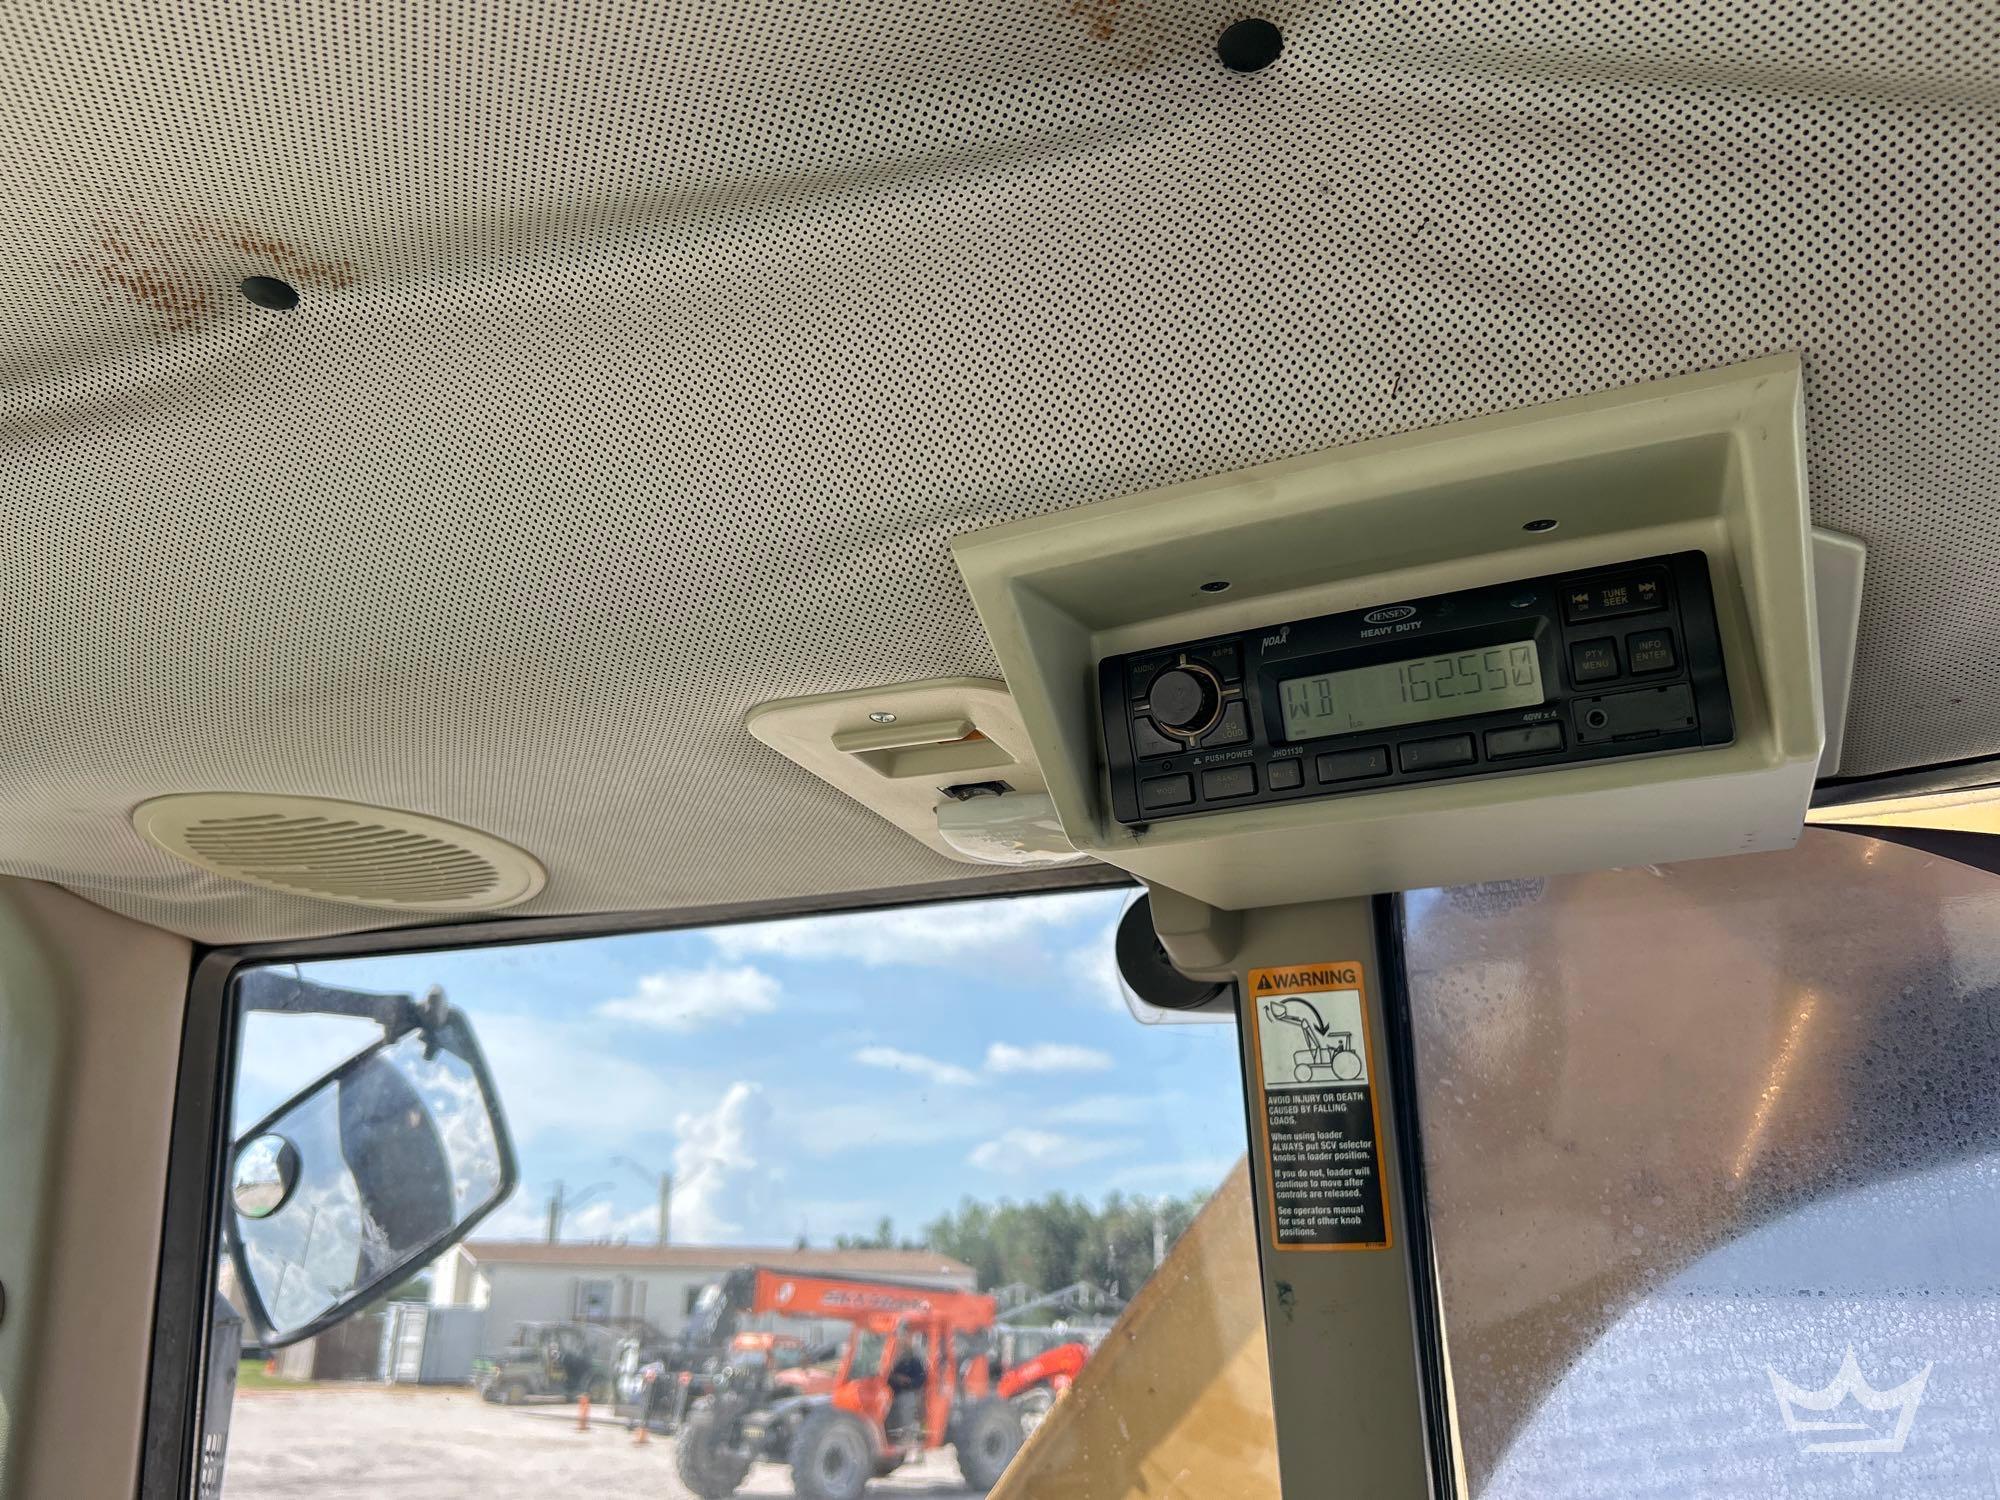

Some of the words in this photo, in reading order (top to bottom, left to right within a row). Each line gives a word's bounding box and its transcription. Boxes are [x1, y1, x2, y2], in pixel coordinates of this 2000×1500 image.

[1601, 587, 1627, 598] TUNE
[1603, 597, 1629, 607] SEEK
[1370, 607, 1410, 622] JENSEN
[1360, 627, 1393, 638] HEAVY
[1396, 621, 1423, 633] DUTY
[1261, 635, 1287, 656] NOAA
[1639, 640, 1662, 650] INFO
[1635, 650, 1667, 662] ENTER
[1583, 659, 1609, 671] MENU
[1287, 678, 1334, 720] WB
[1523, 712, 1542, 721] 40W
[1205, 753, 1225, 763] PUSH
[1226, 750, 1253, 760] POWER
[1368, 756, 1376, 767] 2
[1273, 969, 1356, 988] WARNING
[1269, 1095, 1290, 1104] AVOID
[1293, 1094, 1320, 1103] INJURY
[1323, 1094, 1334, 1102] OR
[1337, 1092, 1363, 1101] DEATH
[1269, 1106, 1298, 1115] CAUSED
[1300, 1105, 1311, 1113] BY
[1313, 1103, 1347, 1112] FALLING
[1270, 1116, 1297, 1125] LOADS.
[1271, 1132, 1292, 1140] When
[1294, 1132, 1315, 1141] using
[1317, 1131, 1342, 1139] loader
[1273, 1142, 1304, 1151] ALWAYS
[1306, 1142, 1318, 1151] put
[1321, 1142, 1337, 1150] SCV
[1339, 1141, 1372, 1149] selector
[1273, 1153, 1296, 1161] knobs
[1298, 1153, 1305, 1161] in
[1308, 1152, 1332, 1160] loader
[1335, 1151, 1369, 1161] position.
[1282, 1171, 1296, 1179] you
[1298, 1169, 1307, 1177] do
[1310, 1169, 1325, 1178] not,
[1327, 1168, 1352, 1176] loader
[1355, 1167, 1370, 1175] will
[1276, 1180, 1308, 1188] continue
[1310, 1179, 1317, 1187] to
[1344, 1178, 1364, 1186] after
[1277, 1190, 1307, 1199] controls
[1324, 1189, 1362, 1197] released.
[1278, 1207, 1292, 1215] See
[1334, 1205, 1364, 1213] manual
[1279, 1218, 1290, 1226] for
[1308, 1217, 1315, 1225] of
[1318, 1217, 1338, 1225] other
[1341, 1216, 1361, 1224] knob
[1280, 1228, 1317, 1236] positions.
